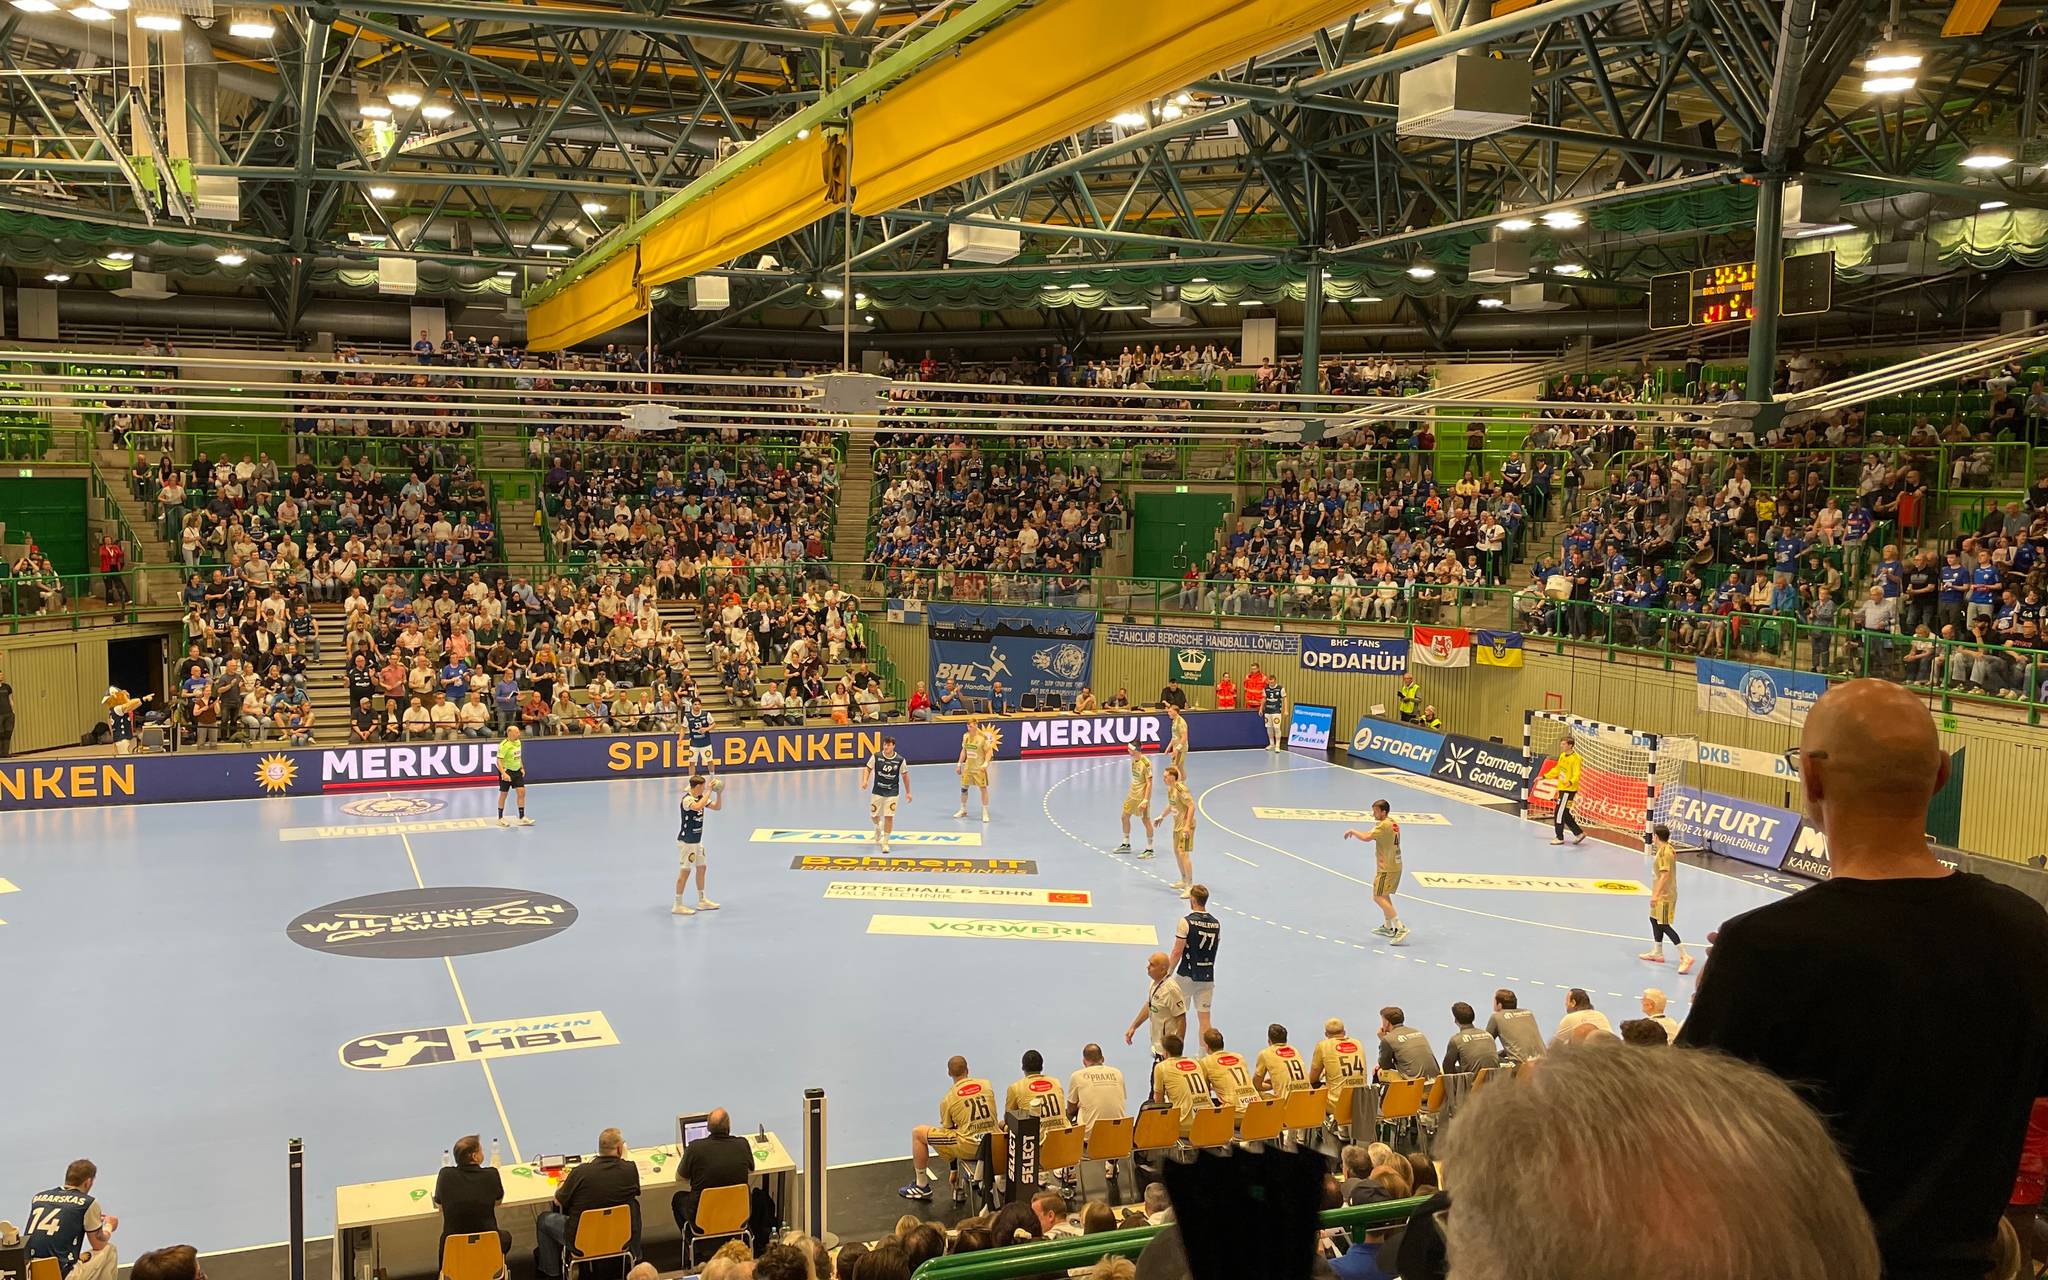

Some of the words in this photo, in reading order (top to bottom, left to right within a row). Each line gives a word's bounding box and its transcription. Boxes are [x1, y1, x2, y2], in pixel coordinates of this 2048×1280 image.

[1119, 631, 1156, 643] FANCLUB
[1158, 632, 1203, 646] BERGISCHE
[1205, 636, 1250, 649] HANDBALL
[1252, 636, 1285, 650] LÖWEN
[1330, 639, 1349, 648] BHC
[1358, 640, 1381, 649] FANS
[1303, 650, 1406, 671] OPDAHÜH
[936, 663, 977, 682] BHL
[1020, 716, 1160, 748] MERKUR
[1943, 717, 1956, 729] WC
[1371, 735, 1433, 763] STORCH
[1700, 745, 1730, 764] DKB
[882, 764, 893, 773] 49
[1468, 767, 1518, 792] Gothaer
[1573, 793, 1647, 824] parkasse
[809, 831, 962, 842] DAKIN
[1712, 832, 1770, 856] WOHLFÜHLEN
[800, 865, 915, 874] PROTECTING
[801, 855, 974, 868] Bohnen
[987, 859, 1027, 869] IT
[829, 884, 961, 895] GOTTSCHALL
[978, 889, 1034, 897] SOHN
[1507, 879, 1586, 889] STYLE
[827, 889, 952, 900] HAUSTECHNIK
[302, 904, 565, 932] WILKINSON
[390, 919, 488, 933] SWORD
[928, 921, 1097, 937] VORWERK
[1198, 930, 1216, 951] 77
[491, 1019, 593, 1035] DAIKIN
[468, 1029, 603, 1054] HBL
[1230, 1066, 1248, 1086] 17
[1283, 1059, 1305, 1081] 19
[1339, 1056, 1364, 1077] 54
[1090, 1072, 1118, 1082] PRAXIS
[1183, 1073, 1206, 1094] 10
[964, 1096, 990, 1121] 26
[1008, 1130, 1016, 1182] SELECT
[1021, 1135, 1035, 1184] SELECT
[28, 1207, 61, 1236] 14
